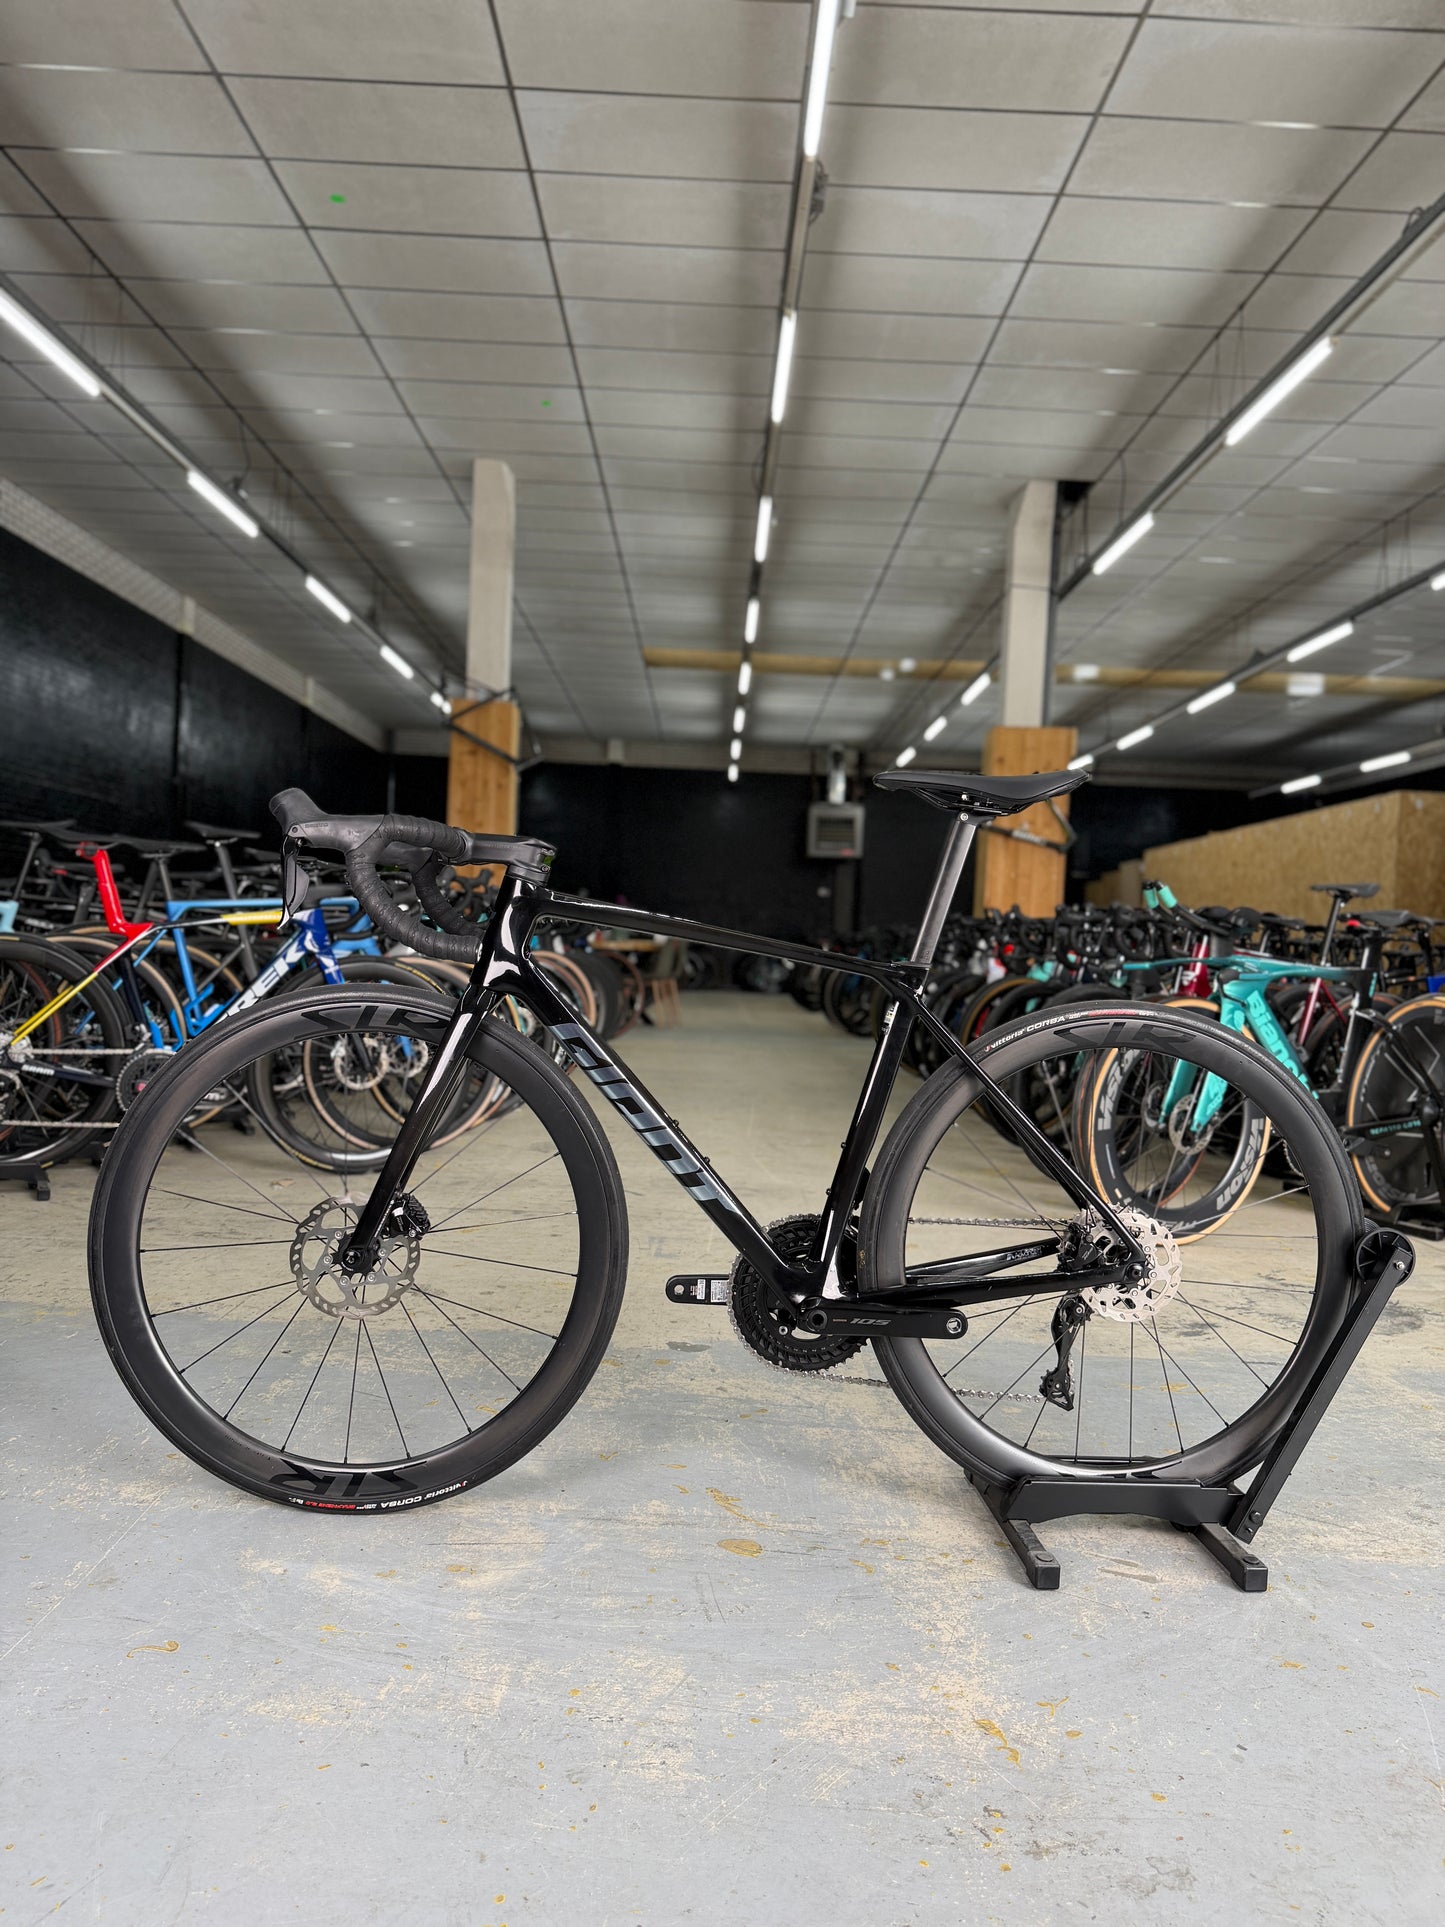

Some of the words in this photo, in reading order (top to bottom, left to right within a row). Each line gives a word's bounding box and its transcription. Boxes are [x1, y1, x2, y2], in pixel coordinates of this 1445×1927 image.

[293, 1005, 450, 1046] SLR
[989, 1028, 1025, 1049] vittoria
[1026, 1015, 1066, 1032] CORSA
[1043, 1021, 1197, 1055] SLR
[548, 1023, 744, 1214] GIANT
[1216, 1118, 1264, 1210] Vision
[850, 1317, 892, 1326] 105
[269, 1458, 428, 1497] SLR
[425, 1483, 463, 1500] vittoria
[380, 1495, 423, 1508] CORSA
